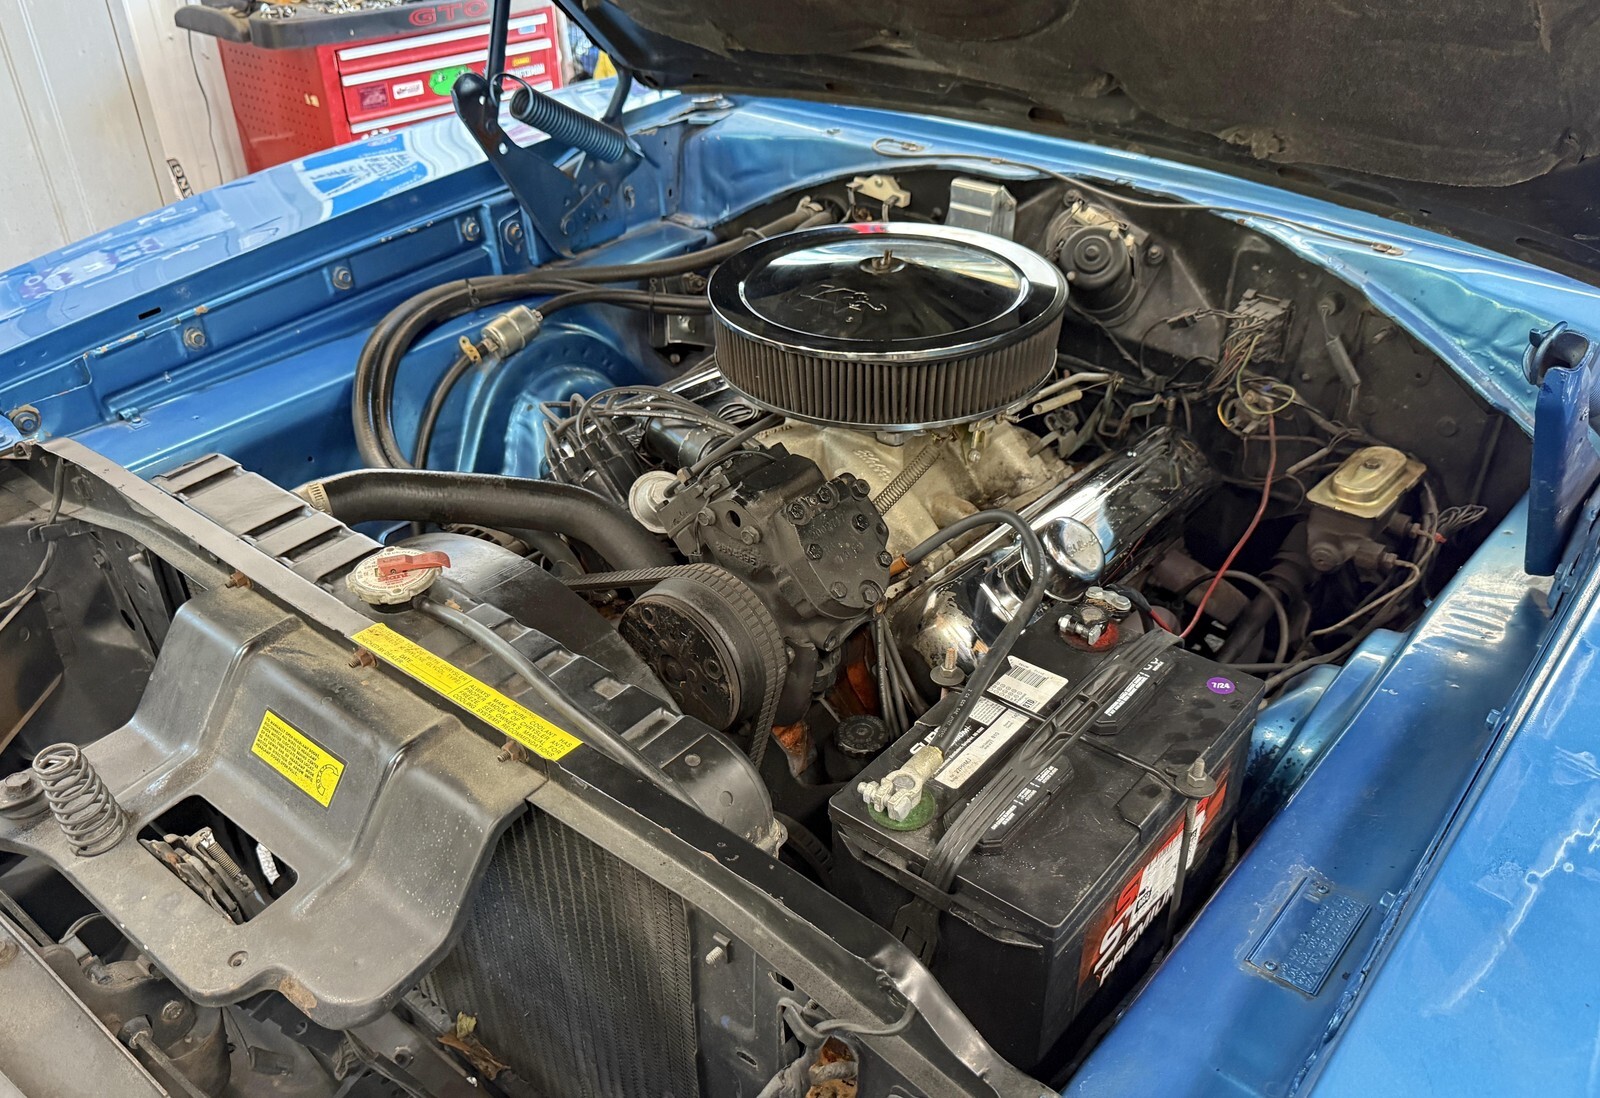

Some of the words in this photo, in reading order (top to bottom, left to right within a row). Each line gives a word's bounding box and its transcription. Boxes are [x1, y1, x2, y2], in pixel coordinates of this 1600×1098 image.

[408, 0, 488, 26] GTO
[357, 635, 378, 648] CHECKED
[425, 662, 445, 674] GLYCOL
[440, 664, 467, 681] CHRYSLER
[452, 693, 476, 708] COOLING
[476, 708, 500, 723] SYSTEMS
[500, 723, 555, 757] RECOMMENDATIONS
[463, 688, 486, 702] PROPER
[486, 701, 510, 716] AMOUNT
[519, 721, 549, 740] CHRYSLER
[550, 740, 566, 750] ANTI-
[469, 684, 490, 697] ALWAYS
[492, 698, 508, 708] MAKE
[510, 709, 527, 720] SURE
[529, 720, 556, 737] COOLANT
[495, 713, 521, 729] OWNER'S
[522, 730, 545, 744] MANUAL
[548, 746, 562, 754] FOR
